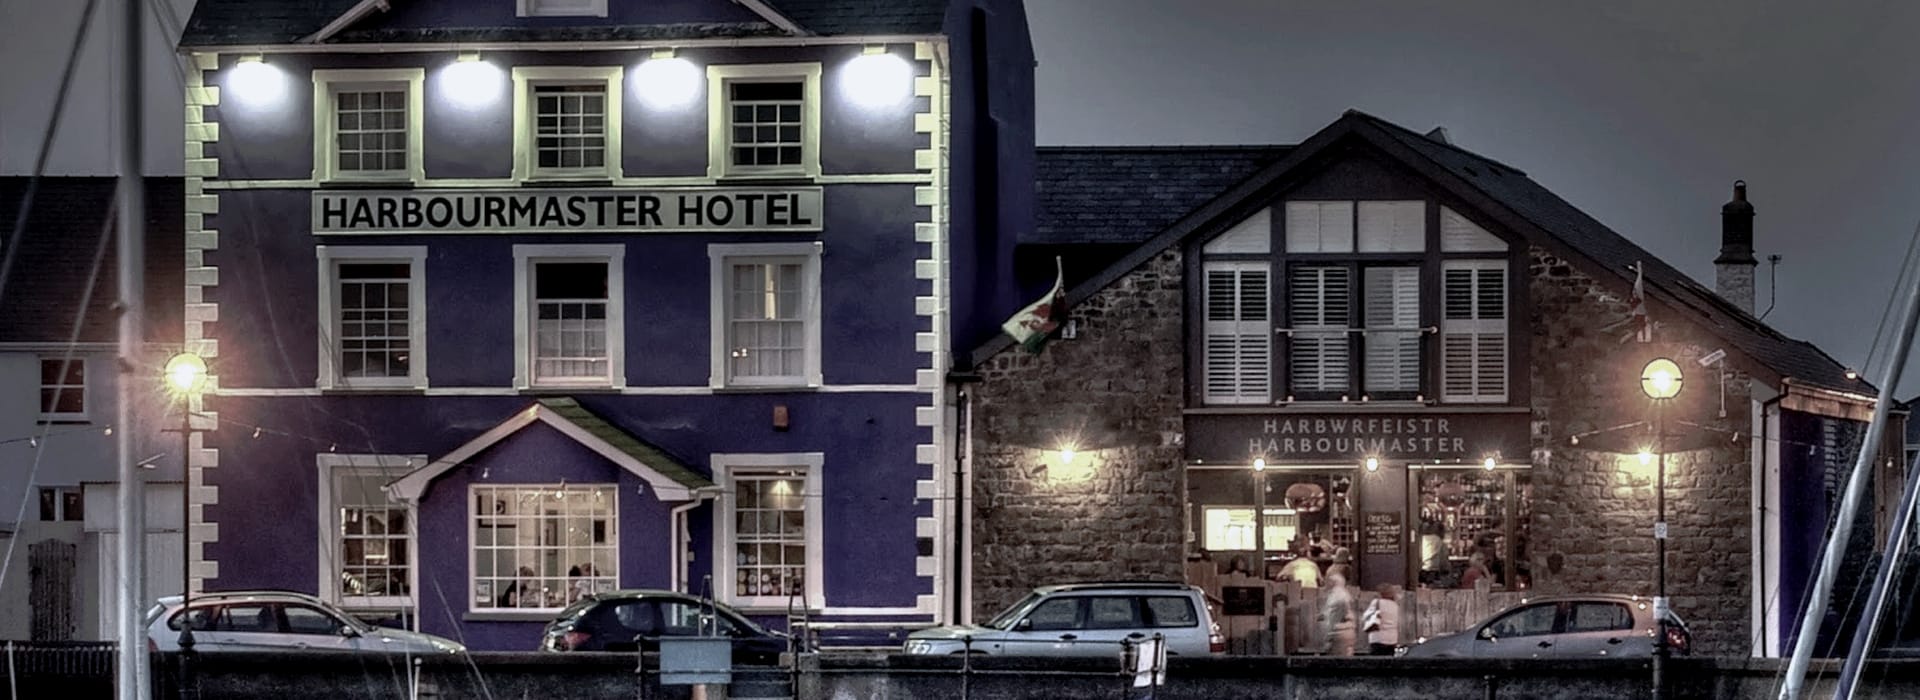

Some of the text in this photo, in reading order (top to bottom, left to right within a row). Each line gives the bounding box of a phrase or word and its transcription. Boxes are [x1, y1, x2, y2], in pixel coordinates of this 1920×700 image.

[322, 194, 812, 228] HARBOURMASTER HOTEL
[1263, 418, 1451, 434] HARBWRFEISTR
[1248, 437, 1466, 454] HARBOURMASTER
